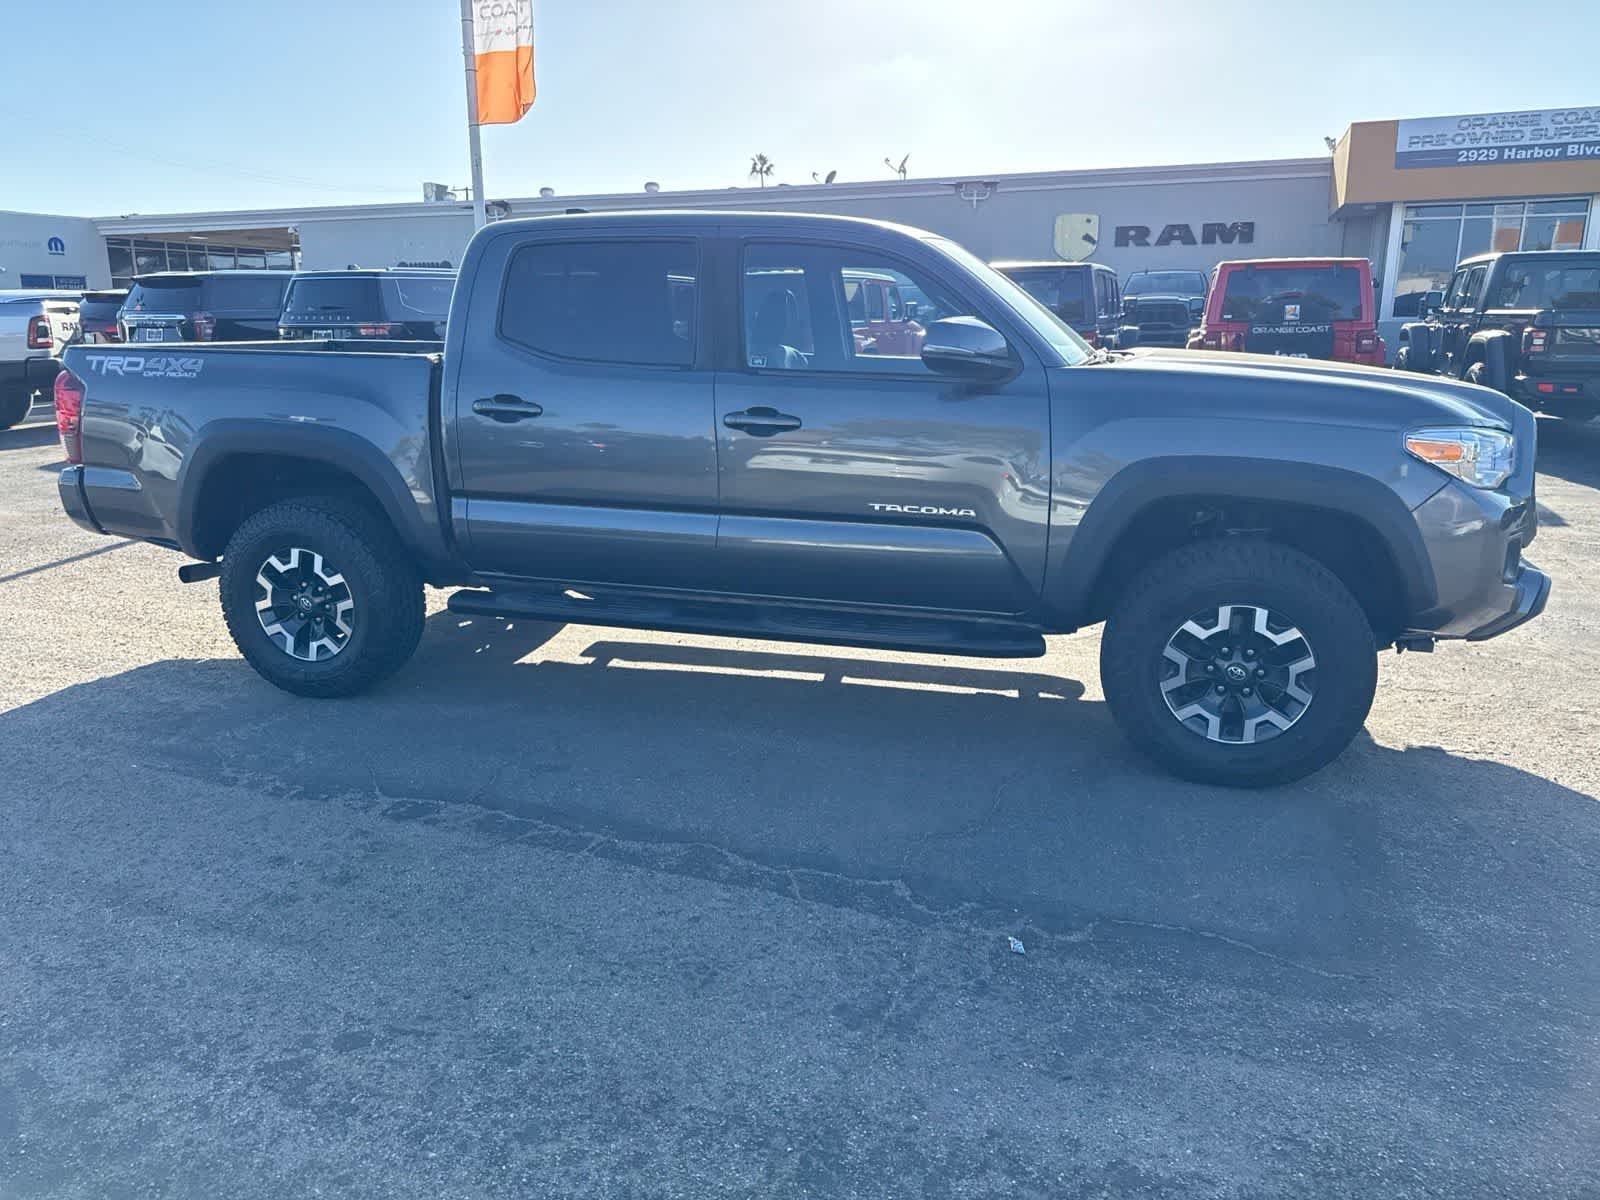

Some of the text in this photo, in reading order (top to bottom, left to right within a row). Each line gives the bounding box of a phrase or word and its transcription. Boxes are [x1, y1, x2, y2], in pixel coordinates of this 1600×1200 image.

[1457, 113, 1541, 130] ORANGE
[1457, 148, 1498, 162] 2929
[1503, 146, 1562, 160] Harbor
[1115, 222, 1255, 247] RAM
[868, 503, 977, 517] TACOMA
